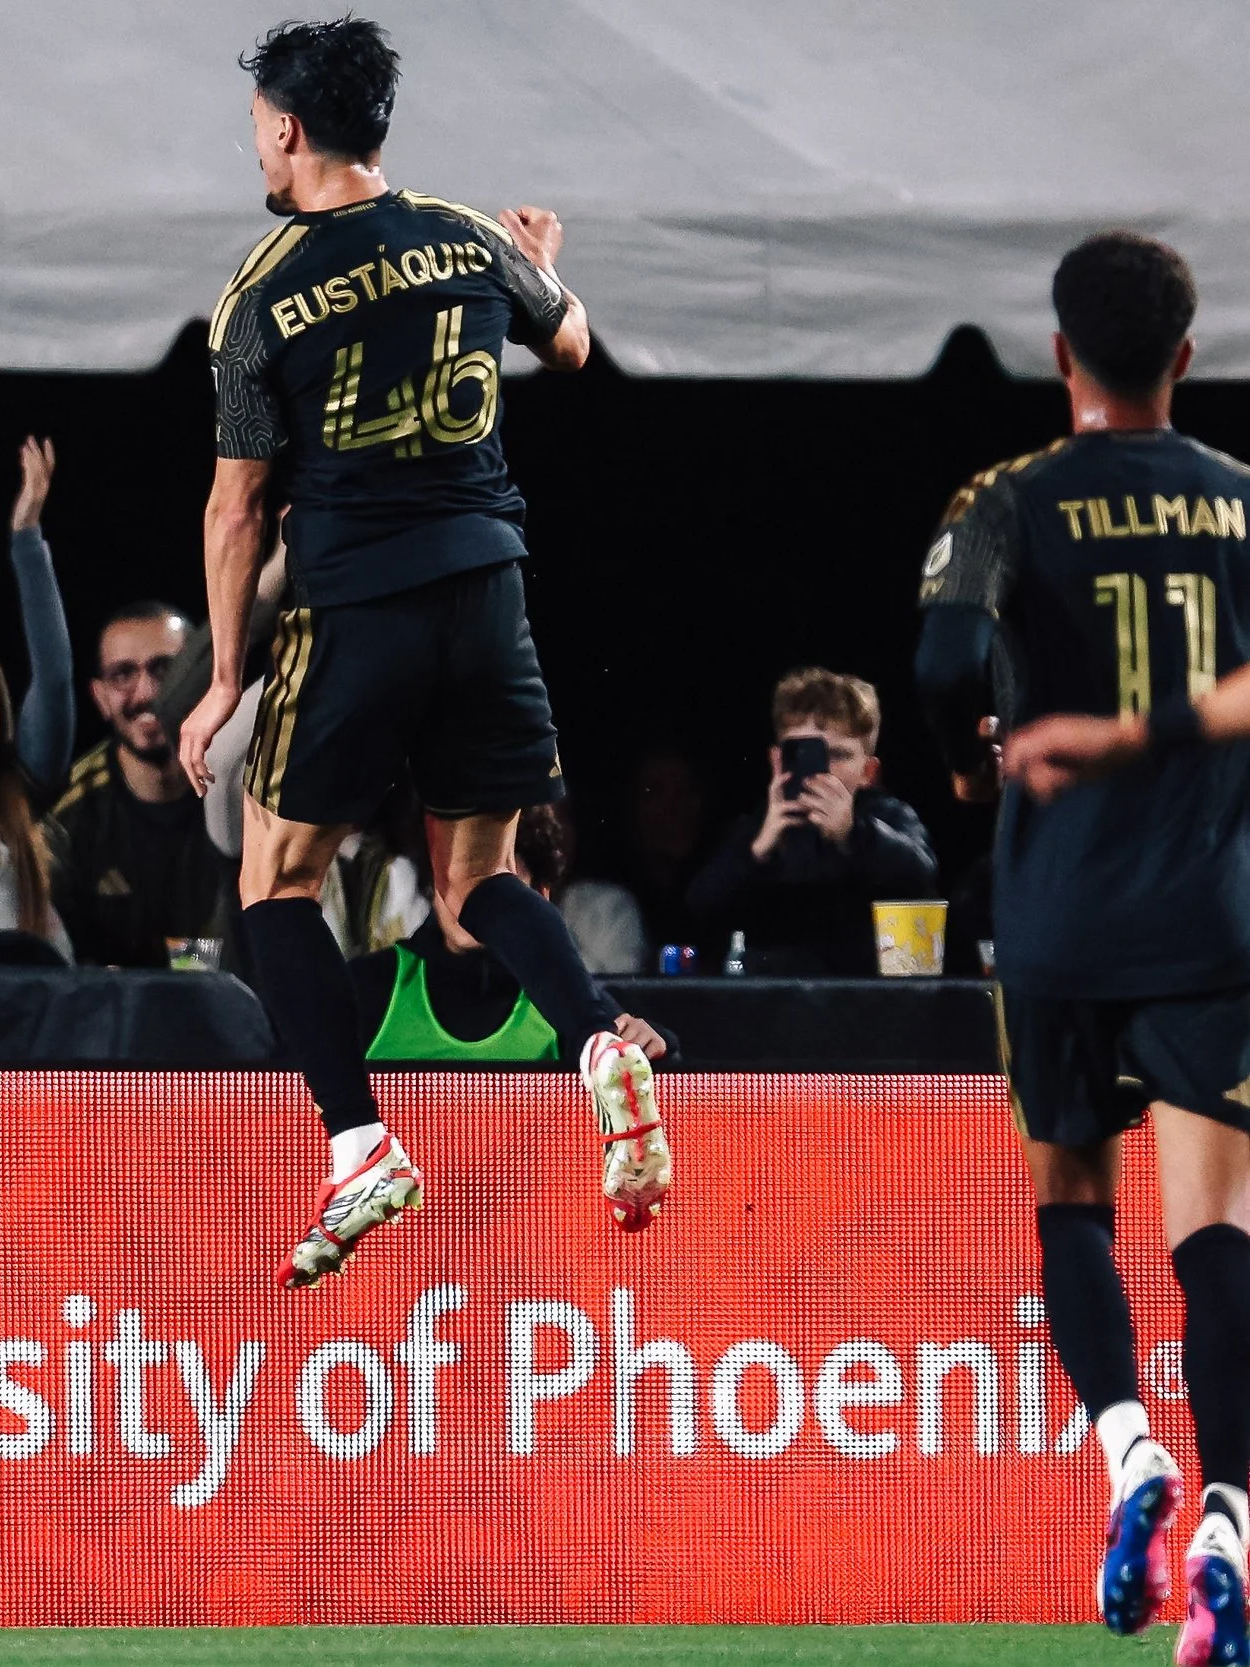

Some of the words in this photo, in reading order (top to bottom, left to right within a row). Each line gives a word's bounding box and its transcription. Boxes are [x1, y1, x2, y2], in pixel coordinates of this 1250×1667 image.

[270, 242, 493, 340] EUSTÁQUIO
[323, 304, 498, 458] 46
[1058, 494, 1248, 541] TILLMAN
[1094, 572, 1217, 722] 11
[296, 1284, 468, 1459] of
